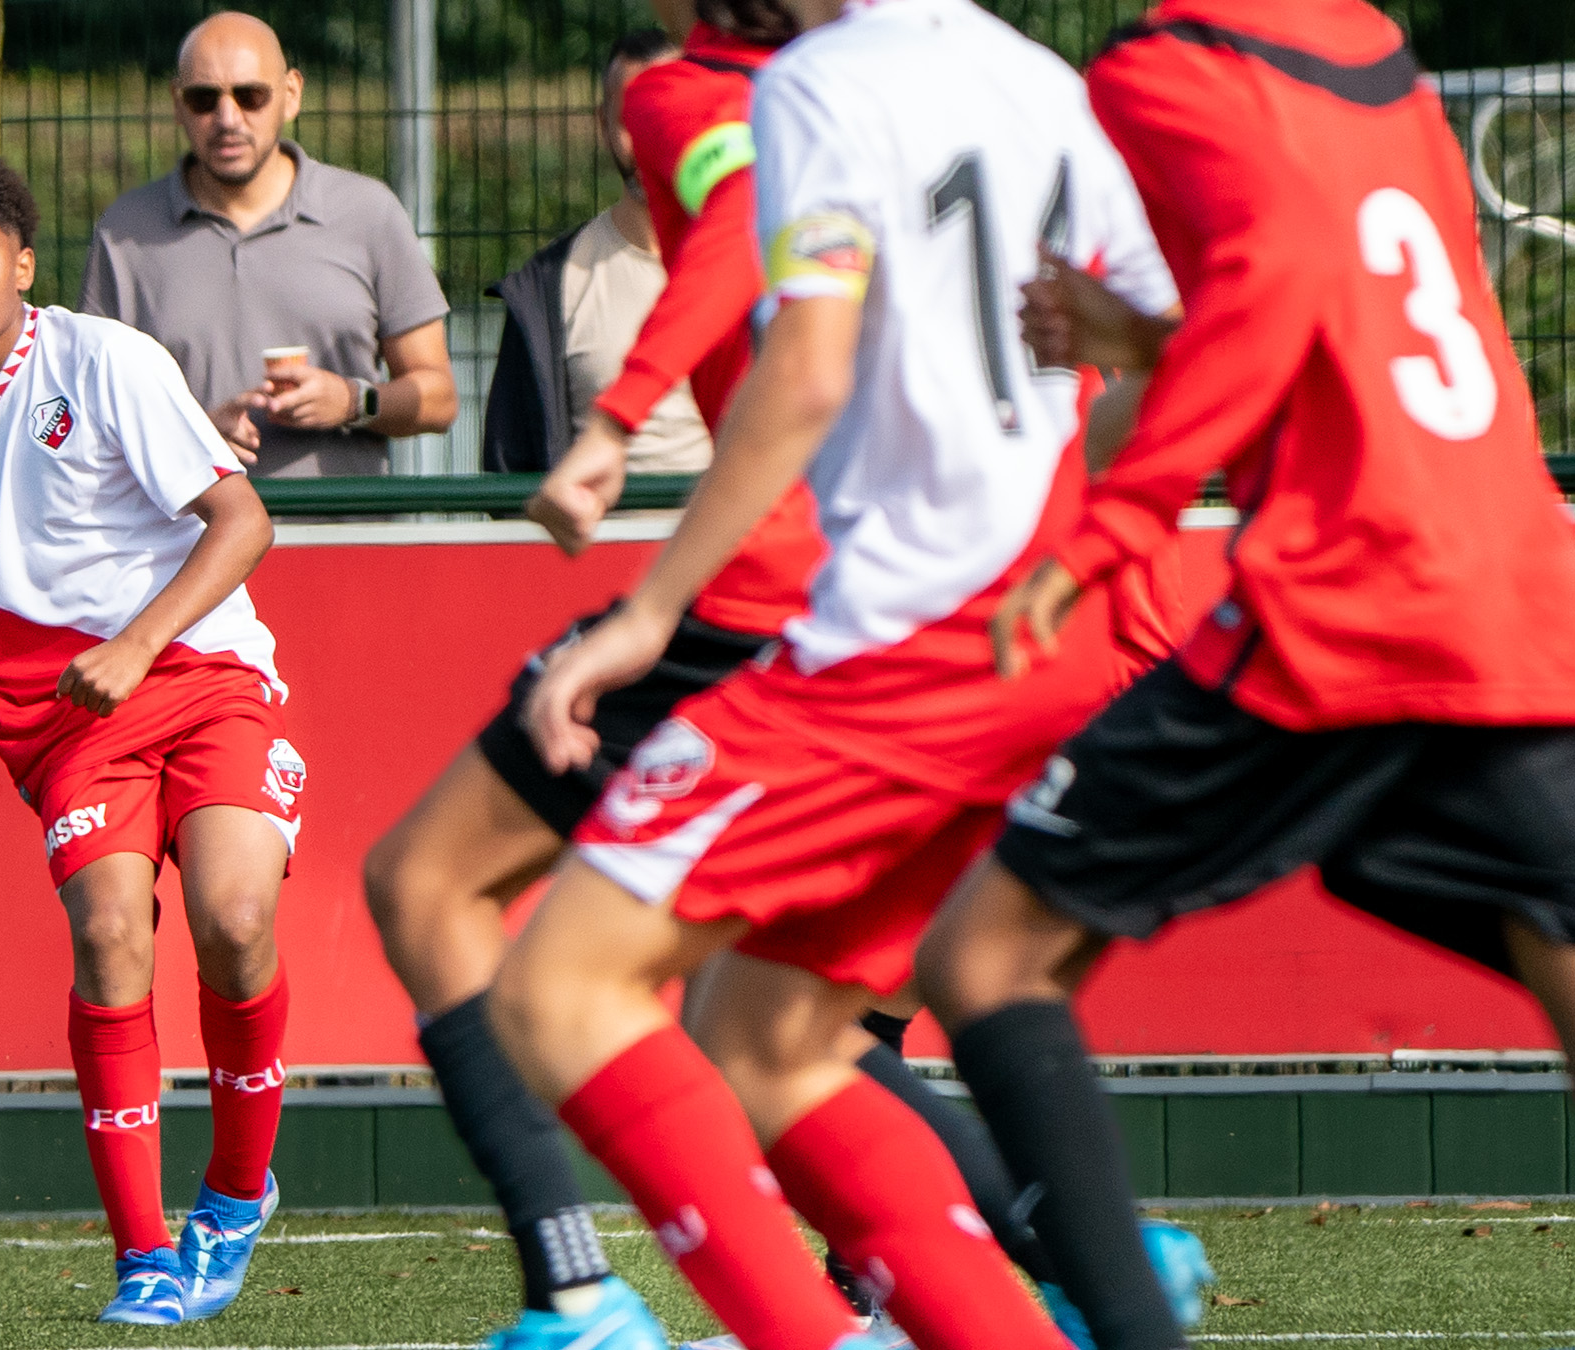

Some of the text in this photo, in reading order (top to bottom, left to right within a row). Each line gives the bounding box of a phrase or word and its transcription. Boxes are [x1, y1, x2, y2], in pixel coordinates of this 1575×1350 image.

[1357, 186, 1498, 441] 3
[38, 400, 68, 443] UTRECHT
[56, 422, 67, 437] C
[45, 802, 107, 860] ASSY
[87, 1101, 158, 1130] FCU
